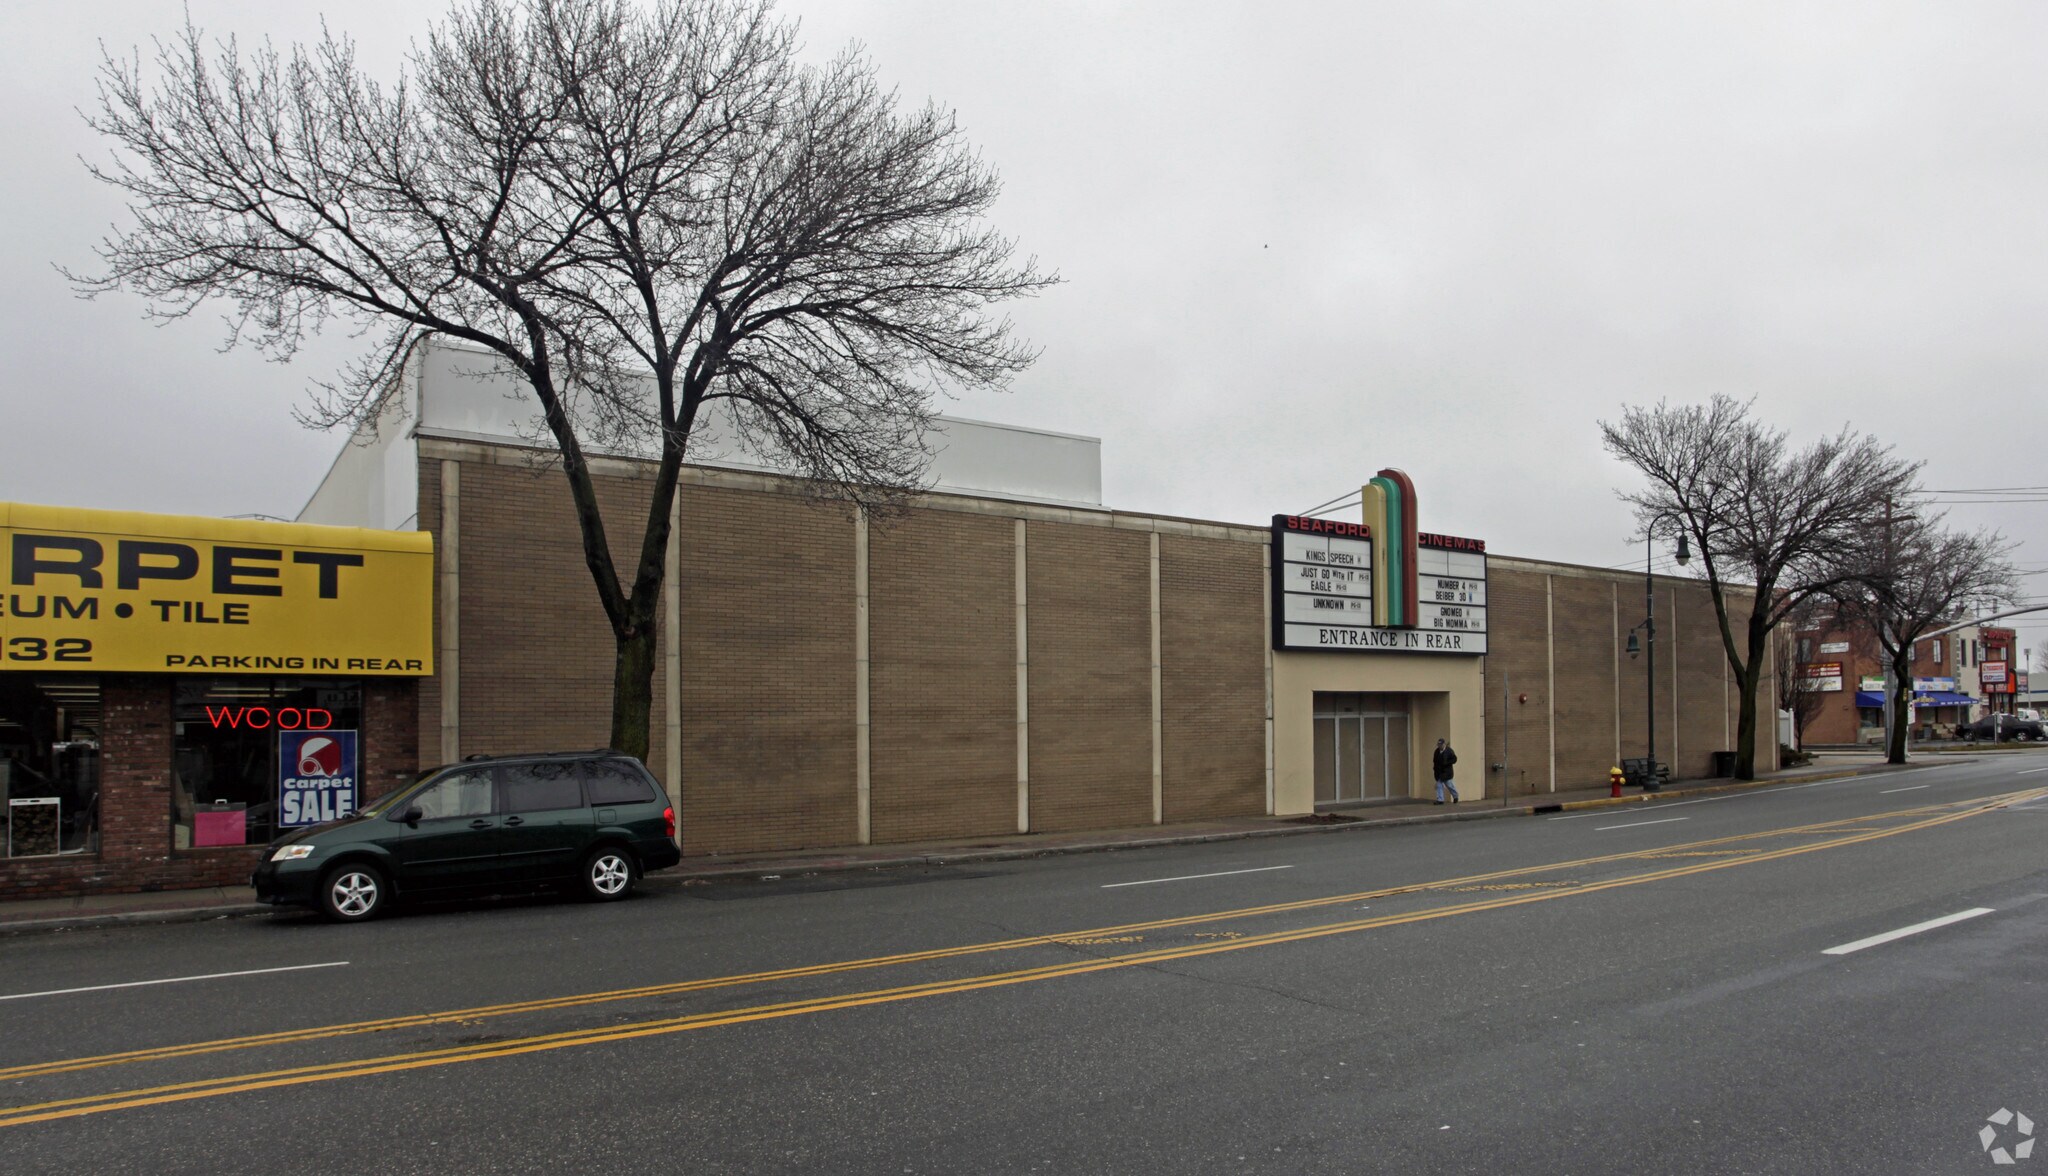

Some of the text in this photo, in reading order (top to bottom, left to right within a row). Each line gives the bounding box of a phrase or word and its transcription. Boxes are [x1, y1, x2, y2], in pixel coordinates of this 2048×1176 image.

[1288, 516, 1486, 552] SEAFORD CINEMAS
[11, 533, 364, 599] RPET
[1305, 549, 1326, 562] KINGS
[1330, 552, 1354, 565] SPEECH
[1301, 567, 1318, 579] JUST
[1321, 568, 1331, 580] GO
[1347, 571, 1354, 582] IT
[1310, 580, 1332, 592] EAGLE
[1437, 579, 1460, 590] NUMBER
[1461, 581, 1466, 590] 4
[1313, 598, 1345, 610] UNKNOWN
[1435, 590, 1455, 601] BEIBER
[1459, 592, 1467, 602] 3D
[0, 593, 98, 620] UM
[151, 600, 250, 625] TILE
[1440, 607, 1463, 617] GNOMEO
[1433, 617, 1444, 628] BIG
[1445, 618, 1468, 629] MOMMA
[1319, 628, 1462, 649] ENTRANCE IN REAR
[0, 636, 93, 662] 32
[166, 654, 423, 672] PARKING IN REAR
[205, 705, 333, 730] WOOD
[283, 789, 353, 824] SALE
